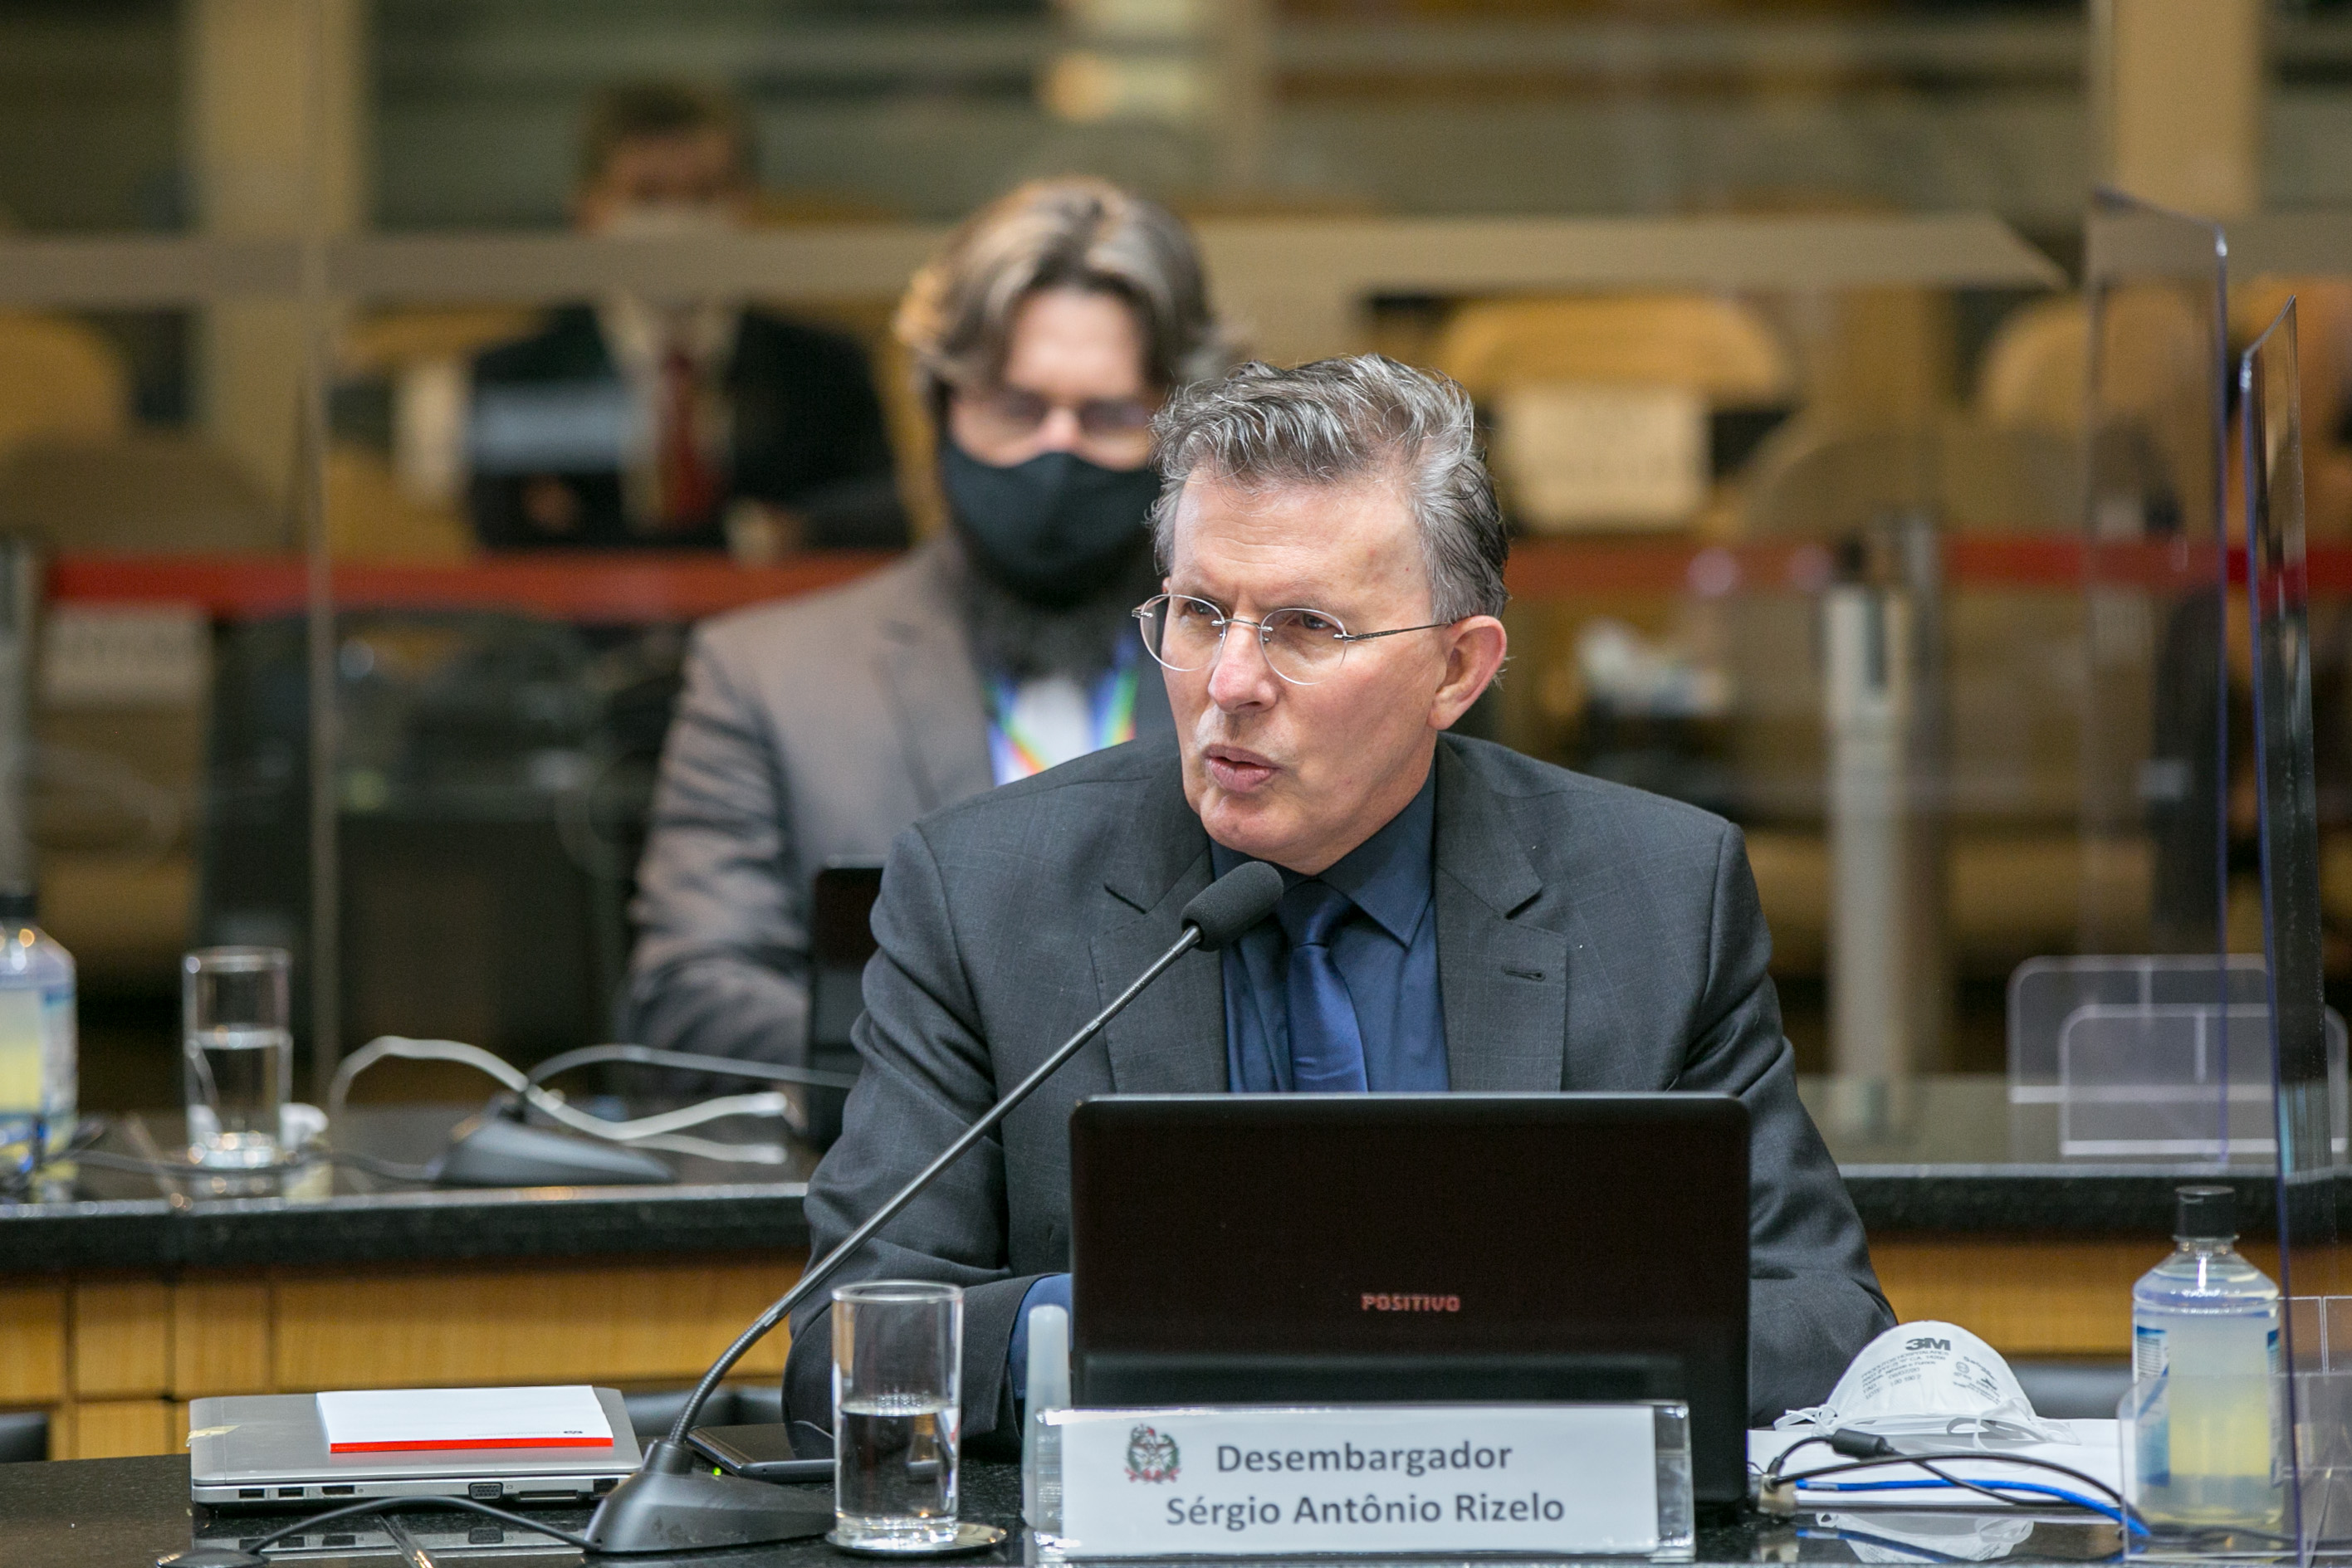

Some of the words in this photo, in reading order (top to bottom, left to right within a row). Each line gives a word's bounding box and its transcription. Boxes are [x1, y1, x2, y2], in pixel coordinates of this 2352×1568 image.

[1361, 1292, 1461, 1312] POSITIVO
[1905, 1337, 1951, 1351] 3M
[1216, 1440, 1513, 1478] Desembargador
[1167, 1494, 1281, 1531] Sérgio
[1293, 1493, 1442, 1524] Antônio
[1455, 1492, 1565, 1522] Rizelo
